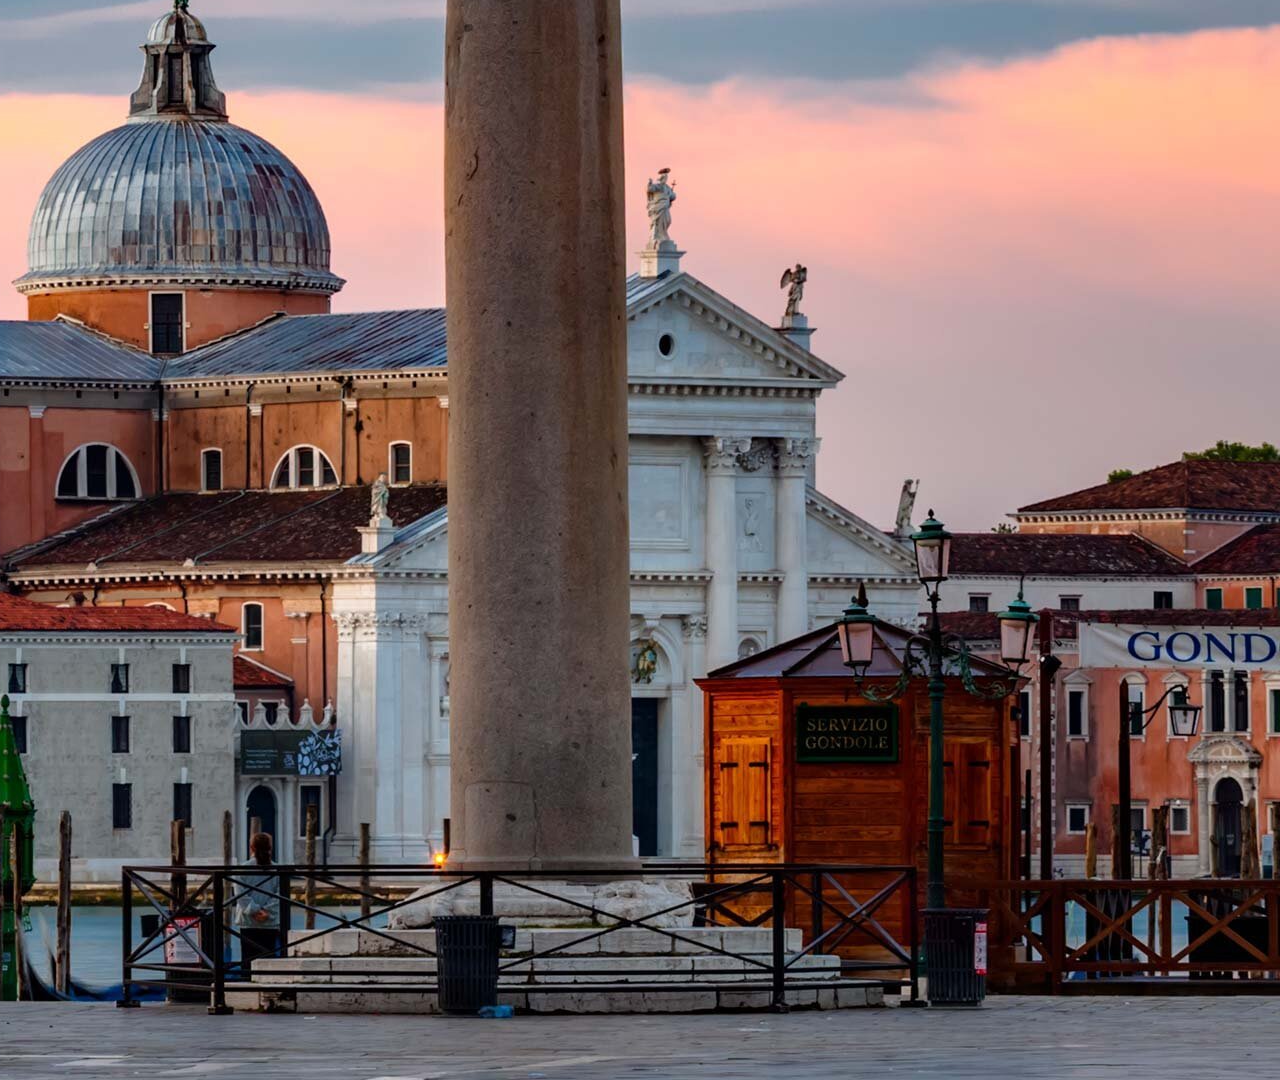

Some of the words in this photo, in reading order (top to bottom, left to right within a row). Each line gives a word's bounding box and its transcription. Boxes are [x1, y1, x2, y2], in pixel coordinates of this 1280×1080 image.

[1127, 631, 1280, 663] GOND
[807, 718, 888, 732] SERVIZIO
[805, 735, 889, 750] GONDOLE
